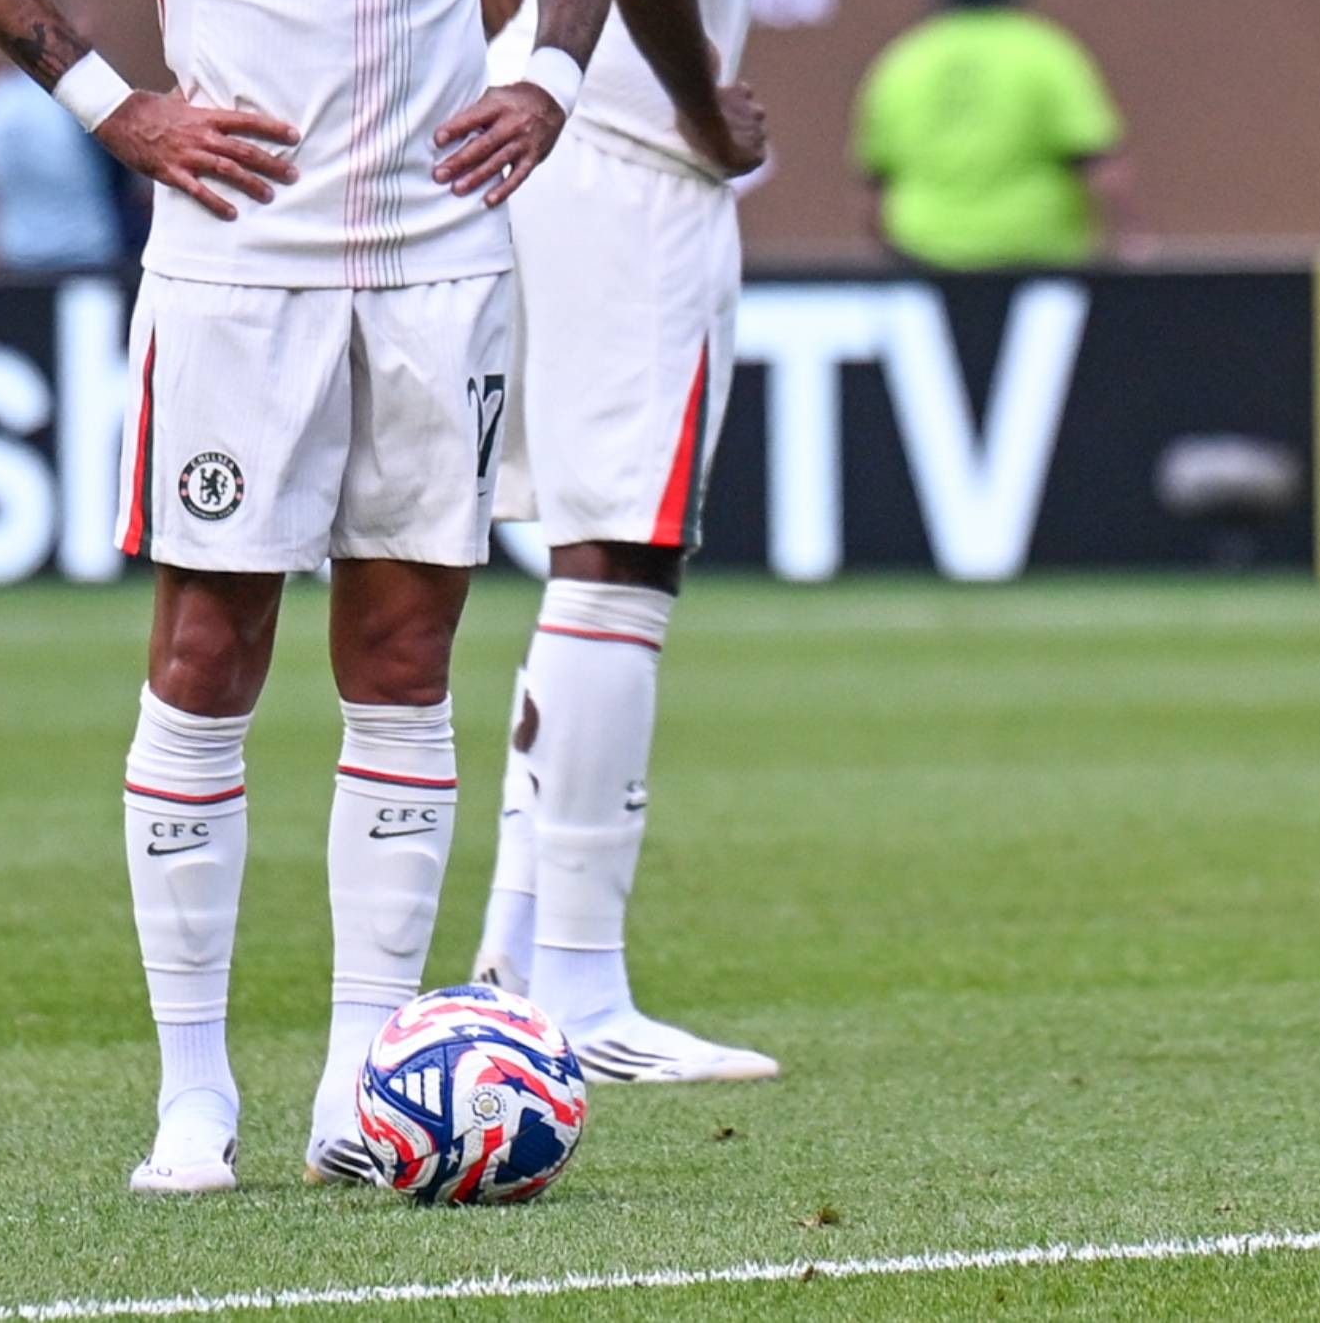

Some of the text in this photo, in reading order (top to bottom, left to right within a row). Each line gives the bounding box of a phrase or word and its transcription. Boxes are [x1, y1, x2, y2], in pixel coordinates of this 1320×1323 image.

[733, 280, 1091, 582] TV
[378, 807, 438, 824] CFC
[150, 821, 209, 838] CFC
